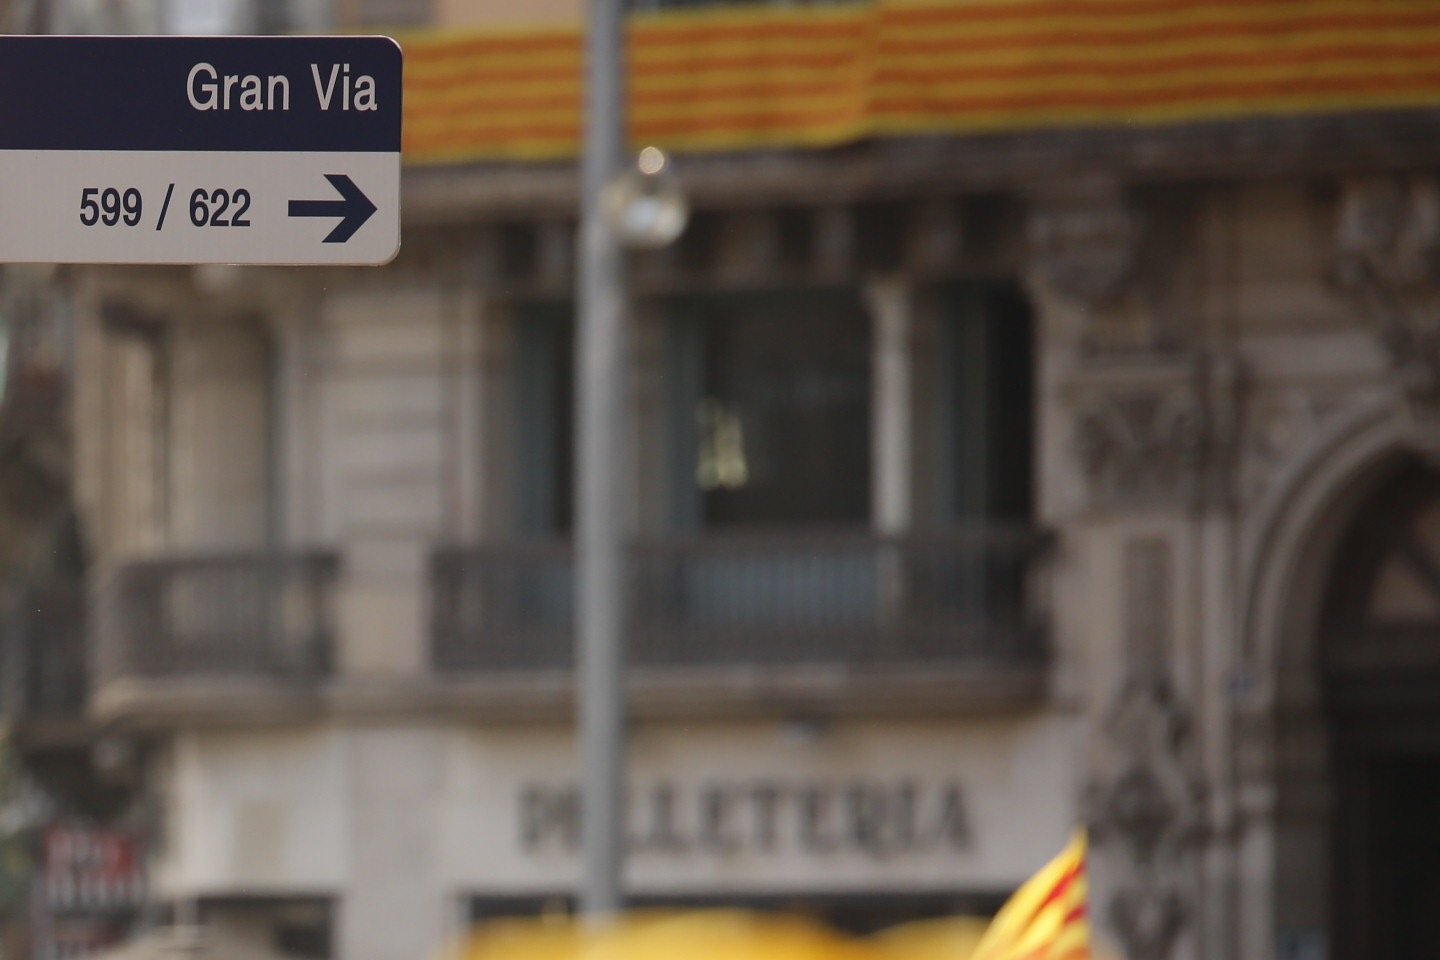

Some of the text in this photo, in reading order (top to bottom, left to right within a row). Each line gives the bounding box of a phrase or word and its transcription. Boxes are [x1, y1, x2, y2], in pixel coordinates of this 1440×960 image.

[187, 63, 378, 111] Gran Via
[79, 183, 251, 231] 599 / 622
